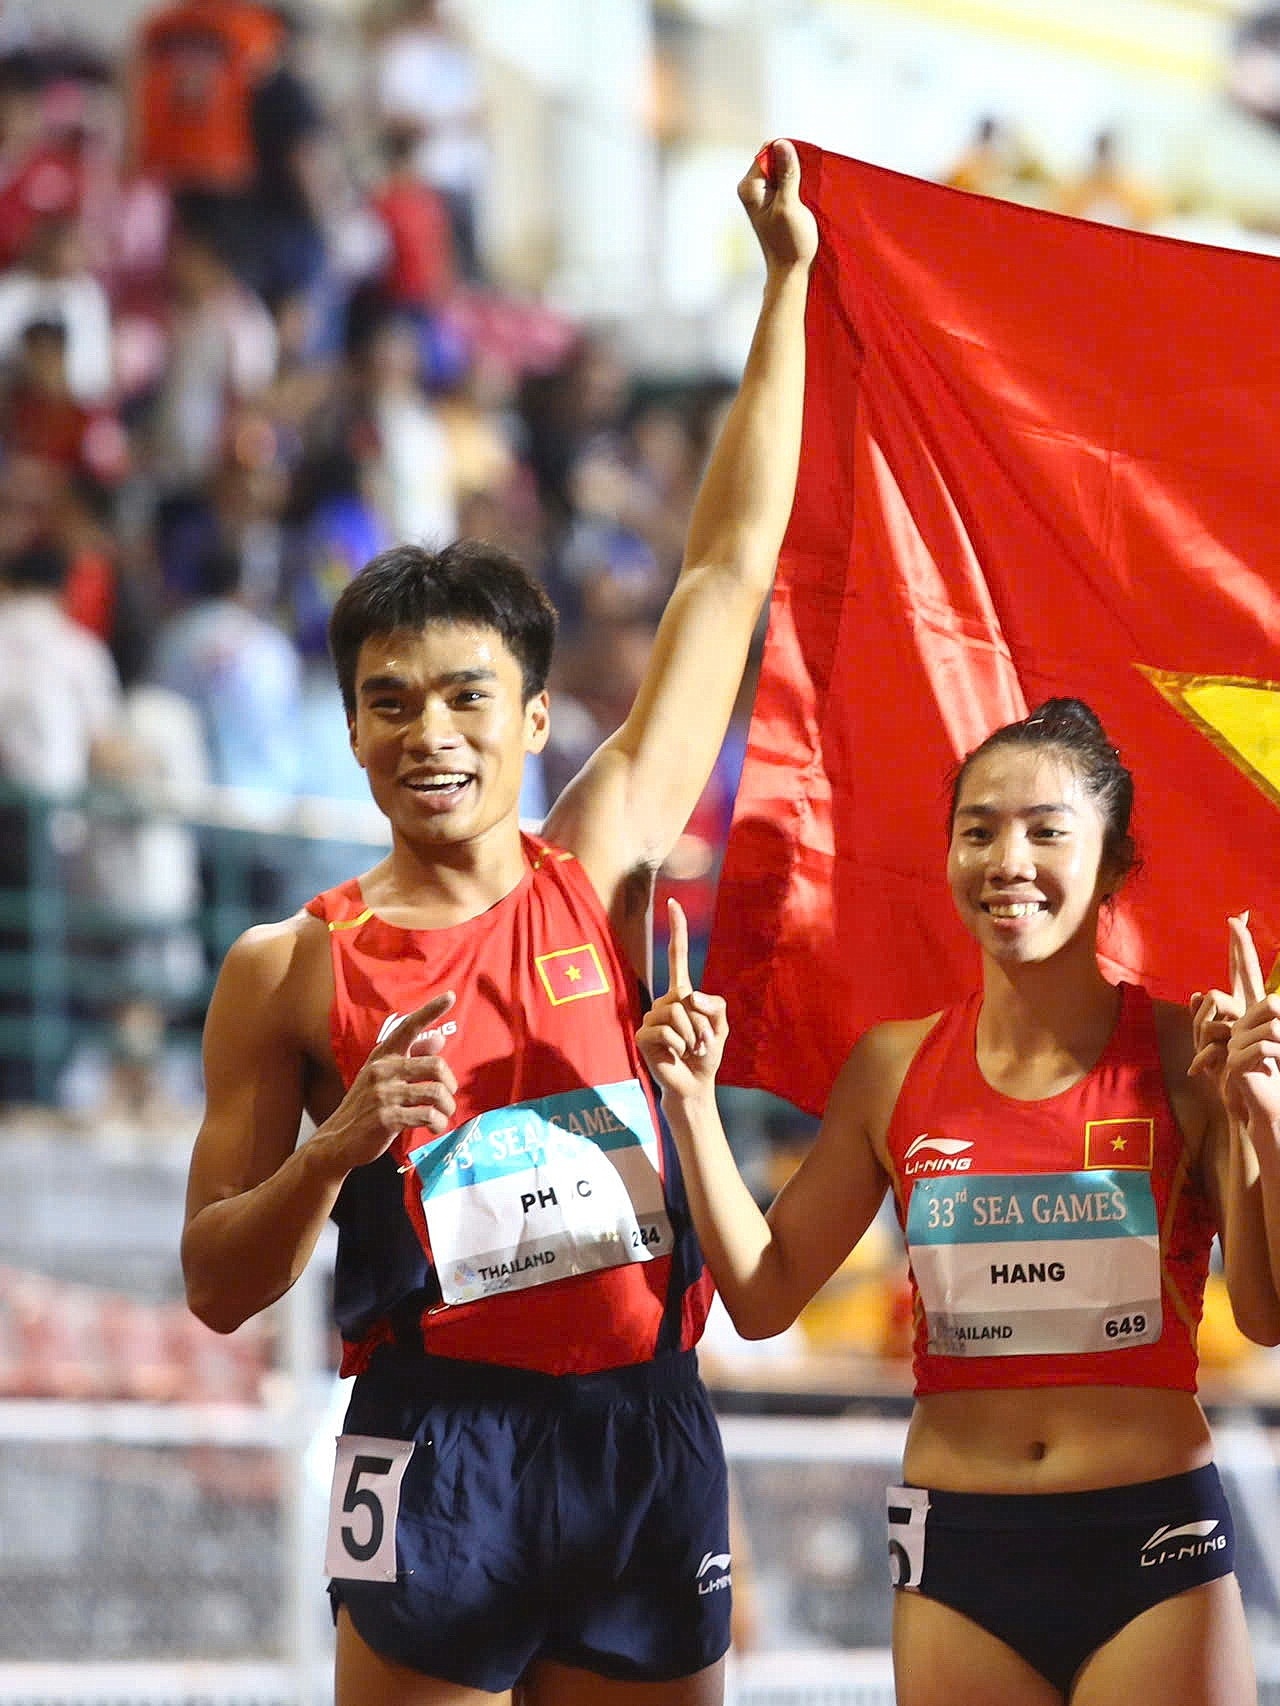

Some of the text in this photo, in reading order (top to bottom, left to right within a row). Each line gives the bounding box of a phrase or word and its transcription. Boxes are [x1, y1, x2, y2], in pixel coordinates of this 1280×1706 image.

[489, 1121, 546, 1160] SEA
[905, 1158, 973, 1175] LI-NING
[520, 1180, 592, 1213] PHC
[928, 1188, 1128, 1228] 33rd SEA GAMES
[478, 1226, 660, 1281] THAILAND 284
[990, 1263, 1065, 1284] HANG
[955, 1315, 1146, 1340] AILAND 649
[341, 1456, 393, 1562] 5
[1141, 1535, 1227, 1566] LI-NING
